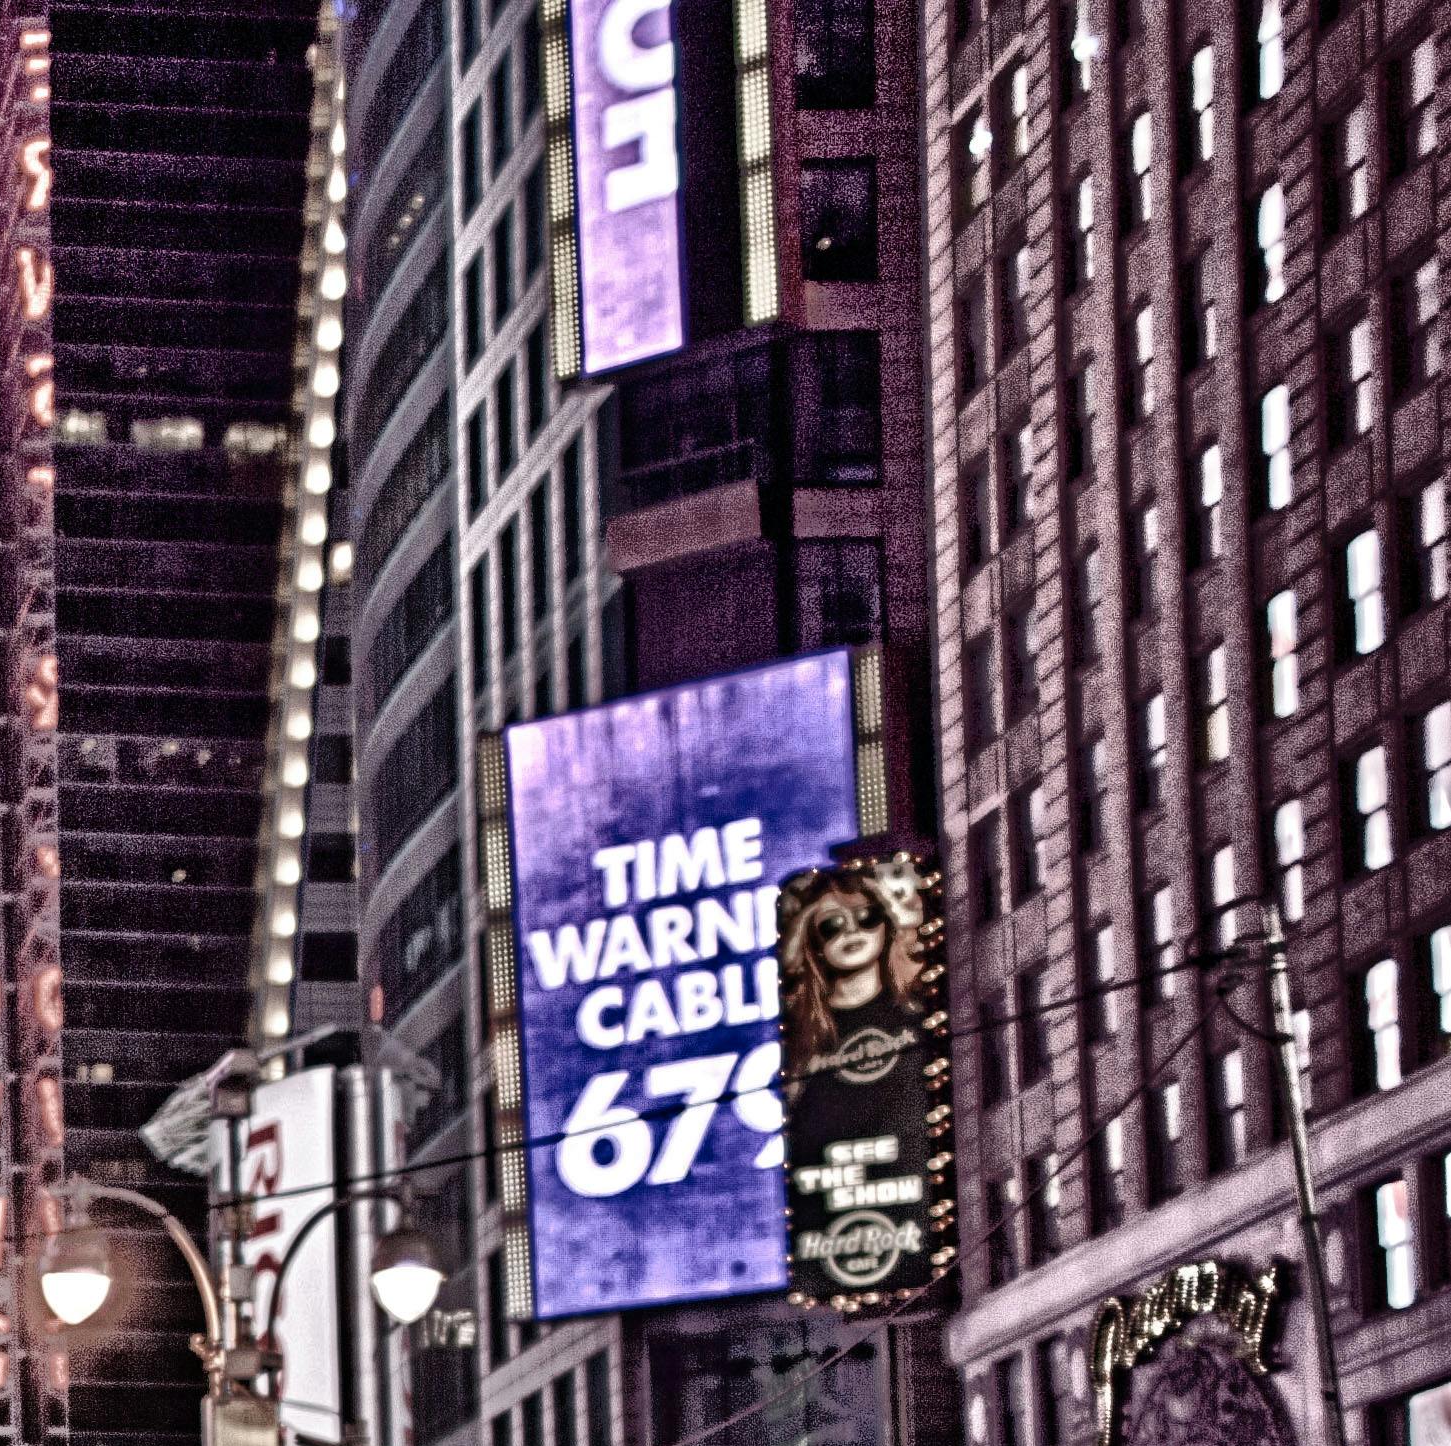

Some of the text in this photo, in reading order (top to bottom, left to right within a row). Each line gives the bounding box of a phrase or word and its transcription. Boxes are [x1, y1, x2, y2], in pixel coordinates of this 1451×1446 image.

[592, 817, 764, 909] TIME
[830, 1175, 923, 1210] SHOW
[799, 1220, 923, 1260] Hard Rock
